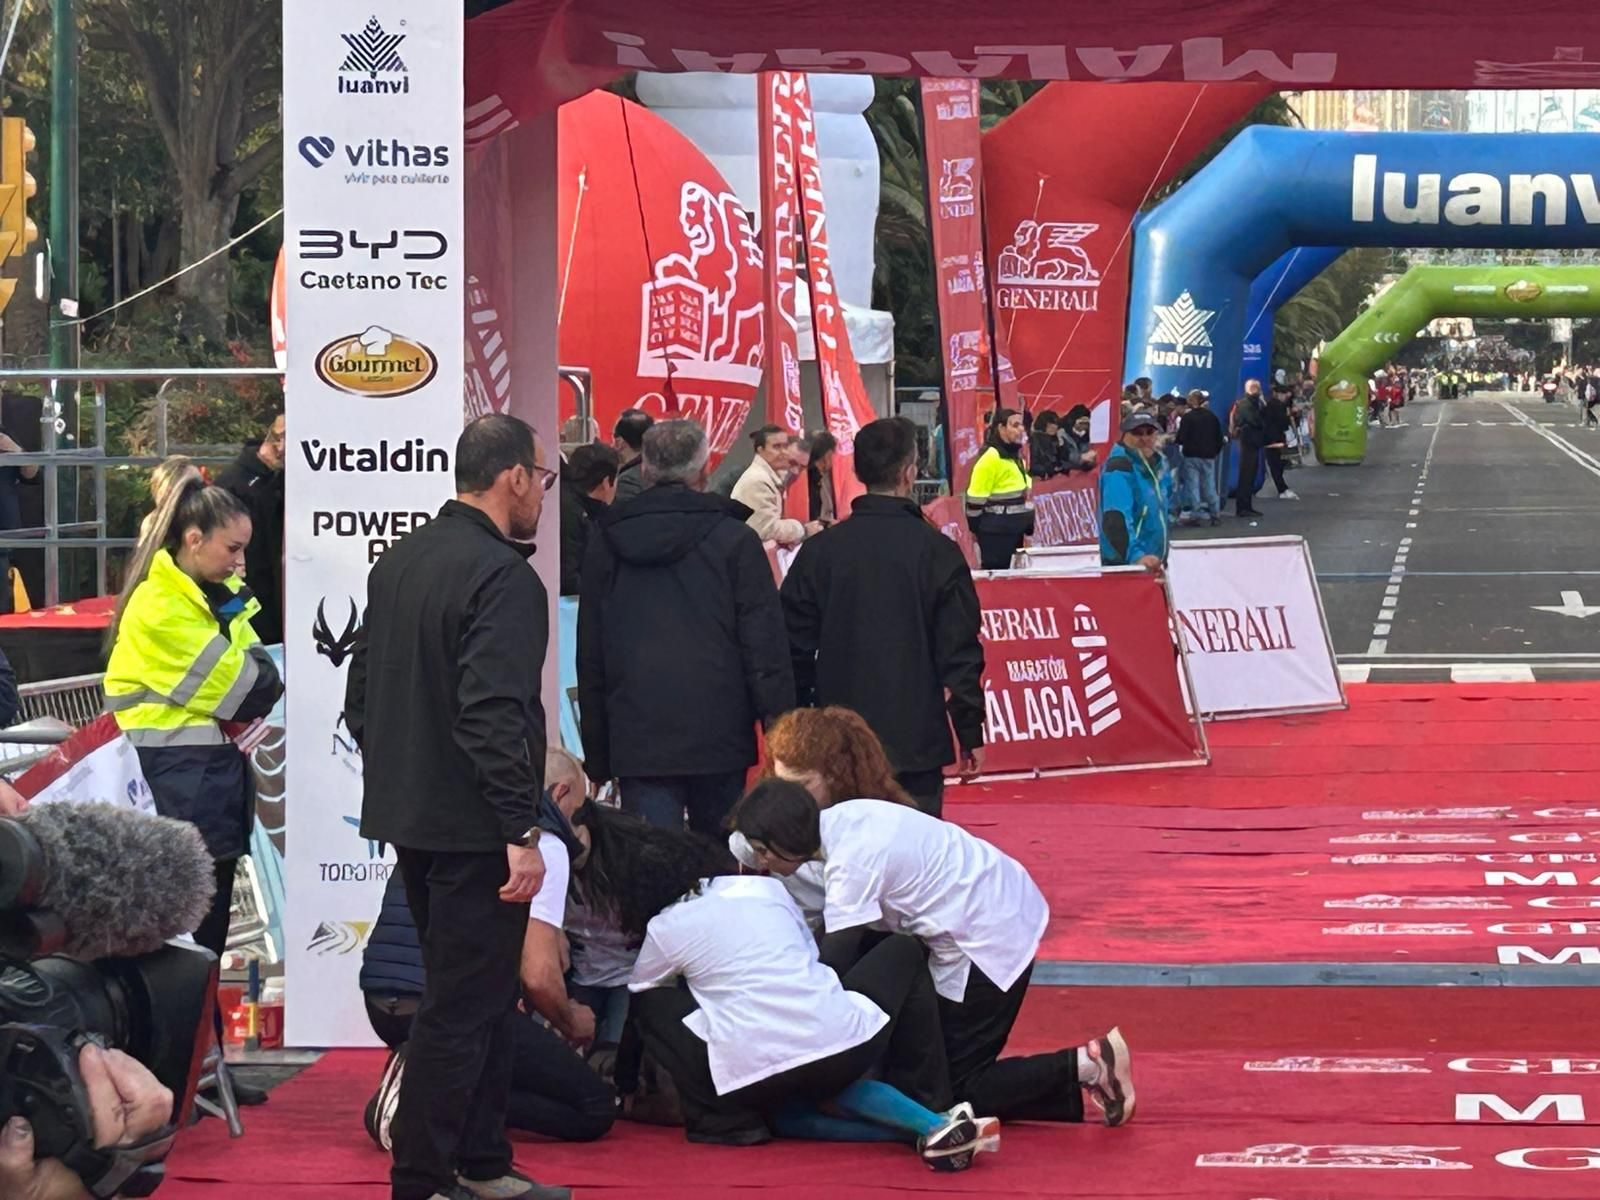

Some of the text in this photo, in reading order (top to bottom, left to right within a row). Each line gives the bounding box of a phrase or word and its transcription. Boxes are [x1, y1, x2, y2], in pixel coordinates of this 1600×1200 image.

[337, 75, 410, 94] luanvi
[344, 139, 450, 168] vithas
[299, 230, 448, 259] BYD
[299, 271, 448, 290] Caetano Tec
[996, 287, 1099, 312] GENERALI
[328, 354, 425, 374] Gourmet
[1144, 344, 1213, 369] luanvi
[300, 438, 449, 473] Vitaldin
[981, 679, 1087, 744] ÁLAGA
